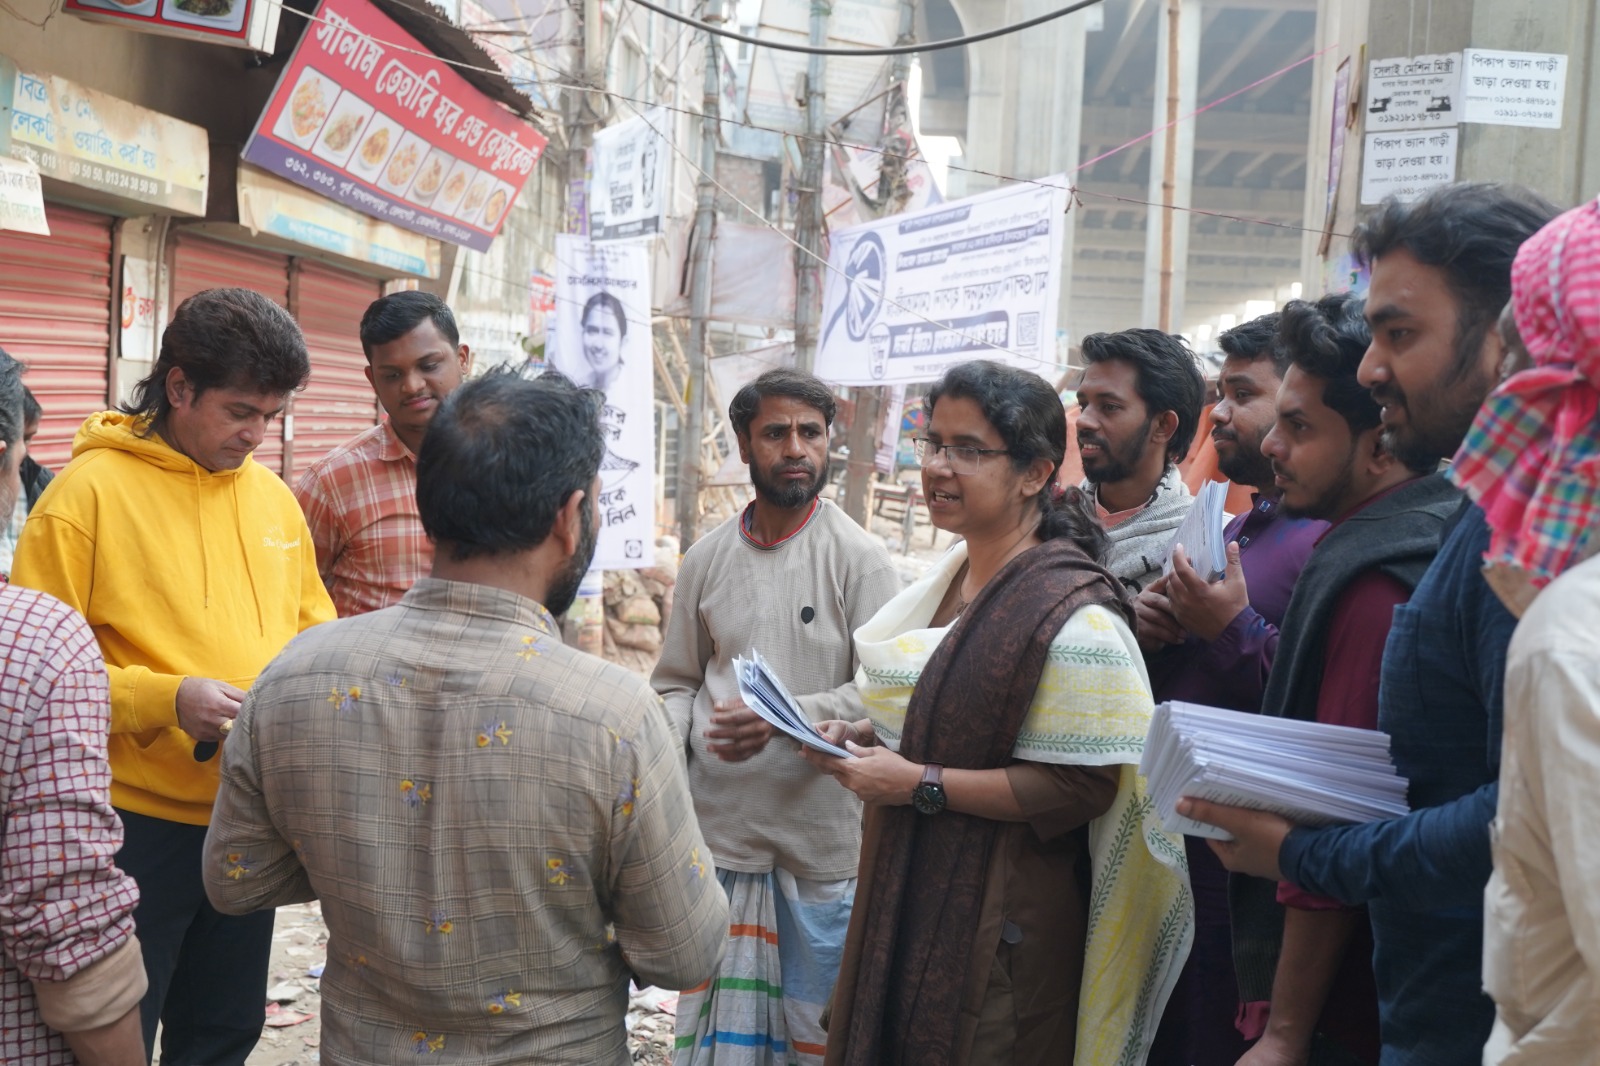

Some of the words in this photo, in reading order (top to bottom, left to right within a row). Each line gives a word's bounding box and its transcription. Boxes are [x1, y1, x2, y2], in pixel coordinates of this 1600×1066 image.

[1373, 63, 1400, 77] সেলাই
[1404, 61, 1431, 75] মেশিন
[1472, 53, 1504, 68] পিকাপ
[1507, 59, 1532, 70] ভ্যান
[316, 7, 384, 79] সালাম
[375, 58, 440, 118] তেহারি
[433, 95, 464, 135] ঘর
[1473, 76, 1497, 89] ভাড়া
[1501, 78, 1532, 89] দেওয়া
[1373, 137, 1401, 150] পিকাপ
[1405, 137, 1426, 148] ভ্যান
